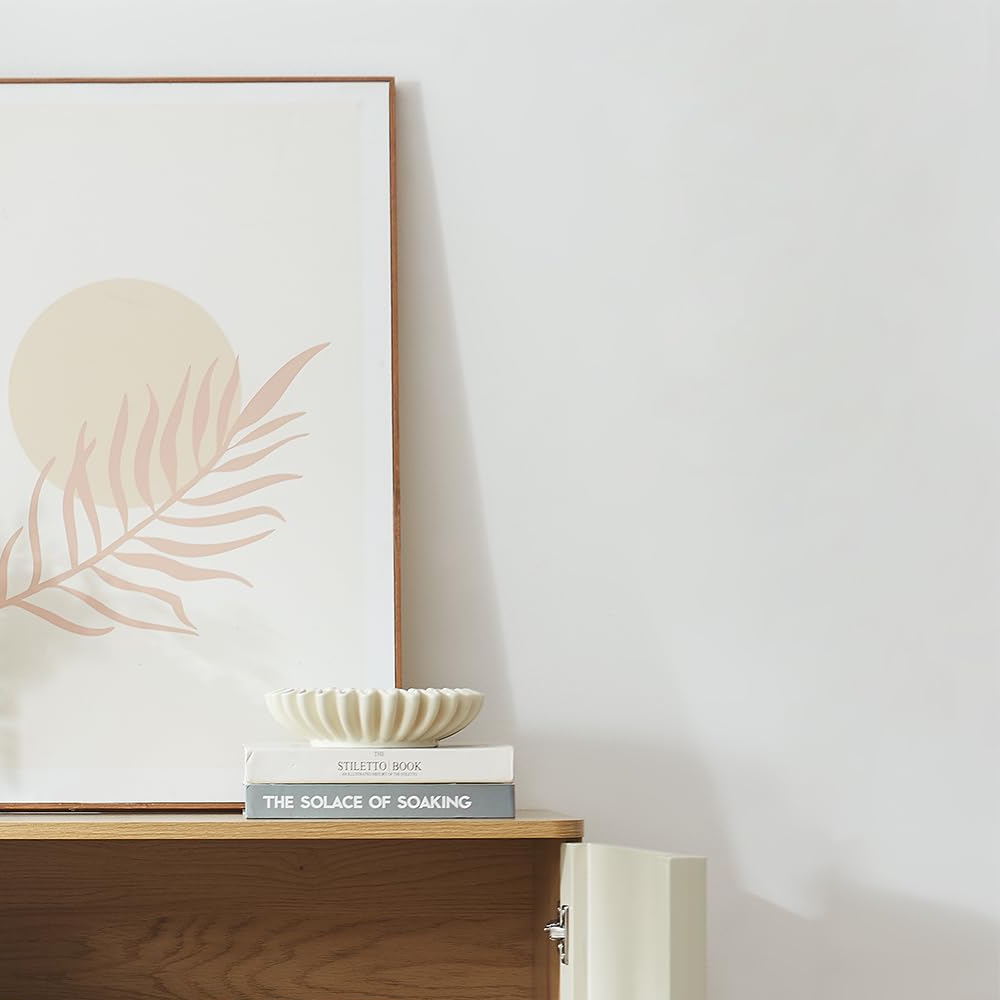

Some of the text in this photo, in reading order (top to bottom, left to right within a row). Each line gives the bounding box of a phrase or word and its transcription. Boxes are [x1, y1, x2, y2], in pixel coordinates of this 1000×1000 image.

[337, 761, 422, 771] STILETTO BOOK
[263, 795, 473, 809] THE SOLACE OF SOAKING
